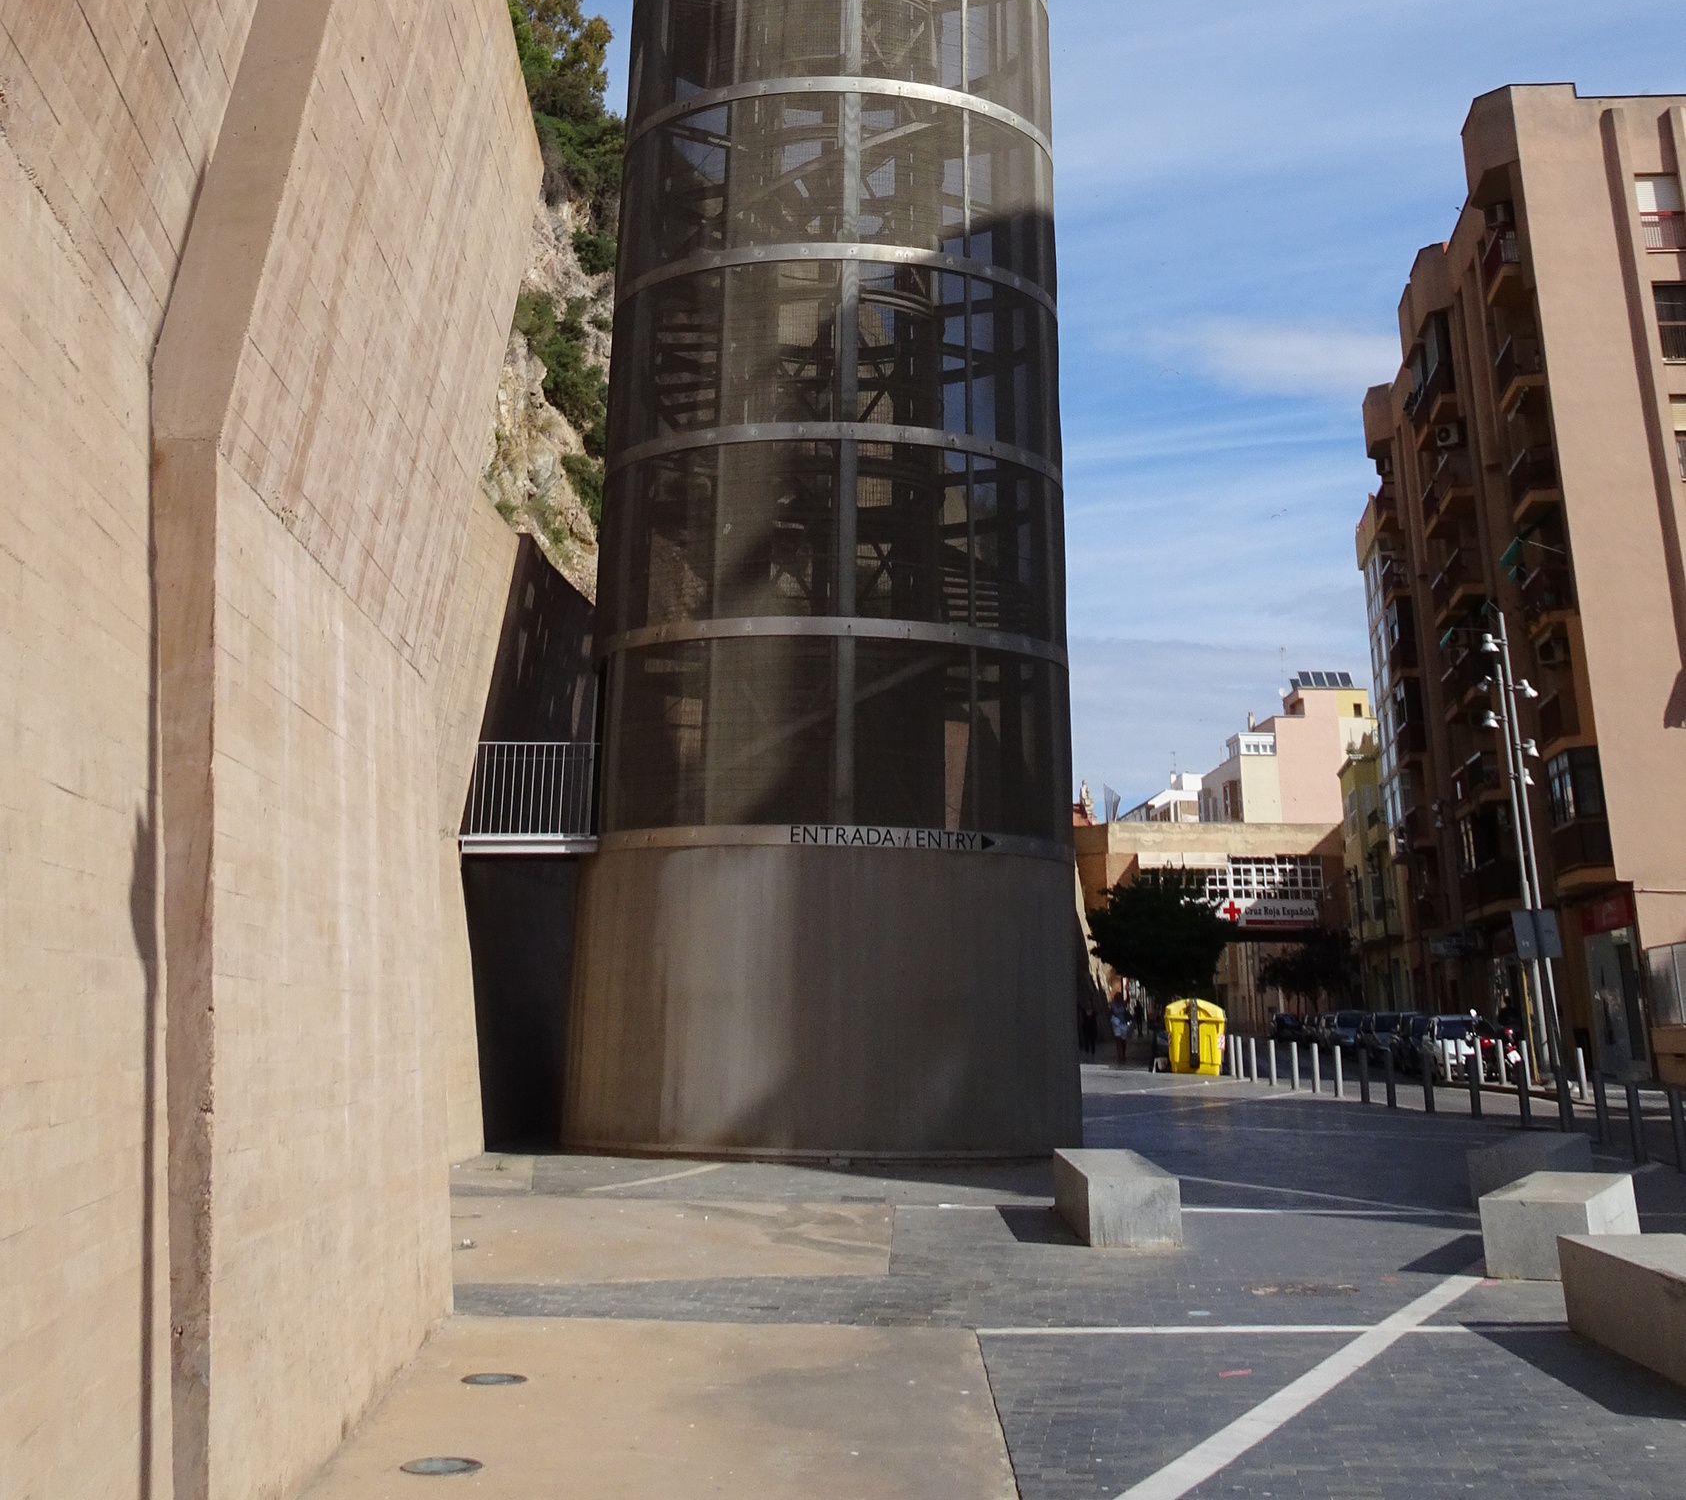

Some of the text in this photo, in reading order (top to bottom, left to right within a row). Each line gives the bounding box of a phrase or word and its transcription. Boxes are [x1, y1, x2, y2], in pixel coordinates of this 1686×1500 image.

[789, 825, 896, 847] ENTRADA
[915, 830, 977, 850] ENTRY
[1244, 906, 1315, 918] Cruz Roja Española
